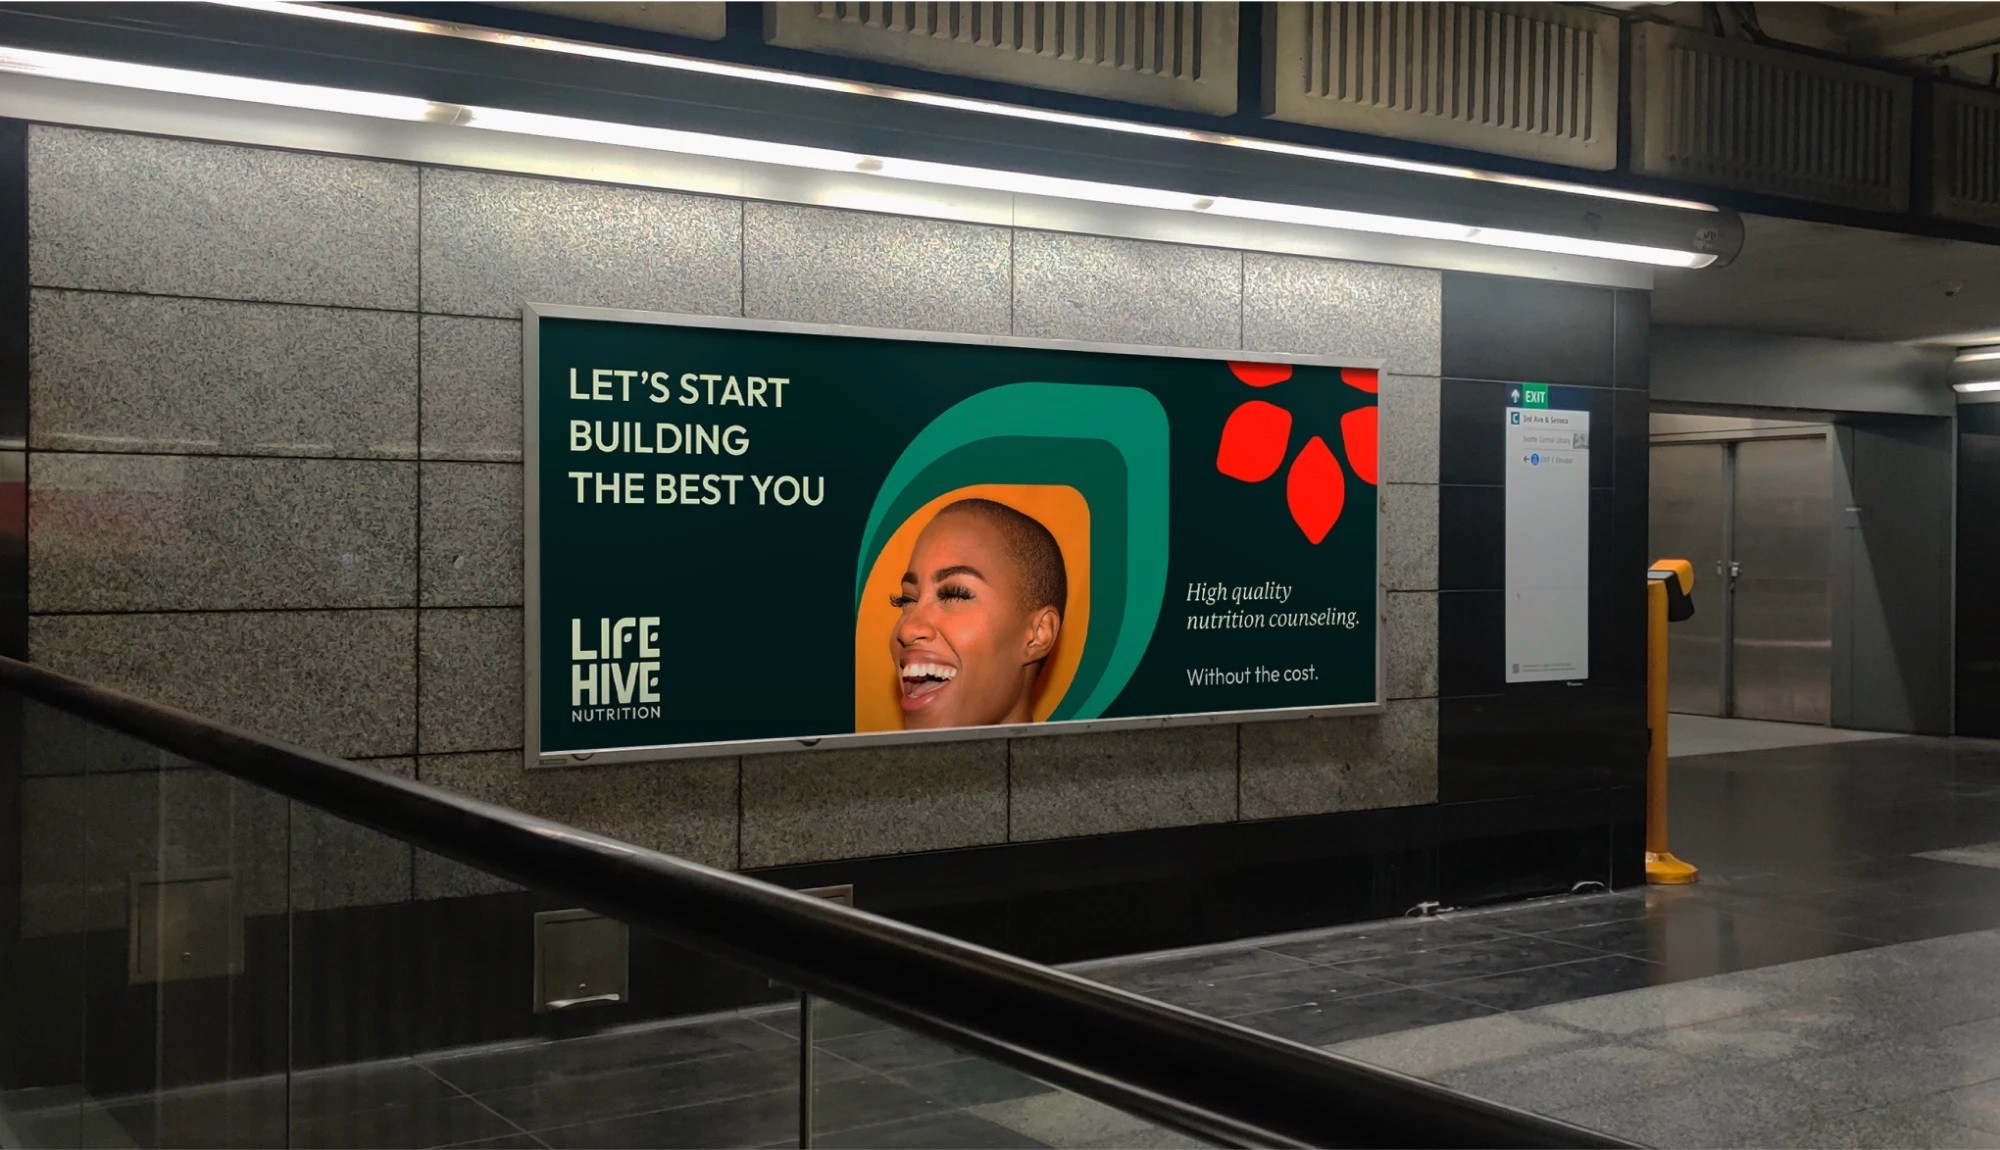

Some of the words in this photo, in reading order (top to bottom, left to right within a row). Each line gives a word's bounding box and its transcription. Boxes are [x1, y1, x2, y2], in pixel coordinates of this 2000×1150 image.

[570, 367, 671, 403] LET’S
[678, 372, 790, 408] START
[1525, 390, 1546, 404] EXIT
[1512, 413, 1519, 424] C
[1533, 414, 1544, 425] Ave
[1550, 416, 1569, 425] Seneca
[570, 419, 750, 456] BUILDING
[568, 471, 645, 504] THE
[656, 473, 744, 505] BEST
[750, 475, 825, 507] YOU
[1186, 581, 1228, 606] High
[1231, 581, 1292, 605] quality
[1186, 609, 1265, 630] nutrition
[1268, 607, 1360, 630] counseling.
[571, 616, 660, 660] LIFE
[571, 661, 660, 706] HIVE
[1186, 666, 1251, 687] Without
[1254, 664, 1280, 684] the
[1283, 663, 1319, 682] cost.
[571, 705, 661, 723] NUTRITION
